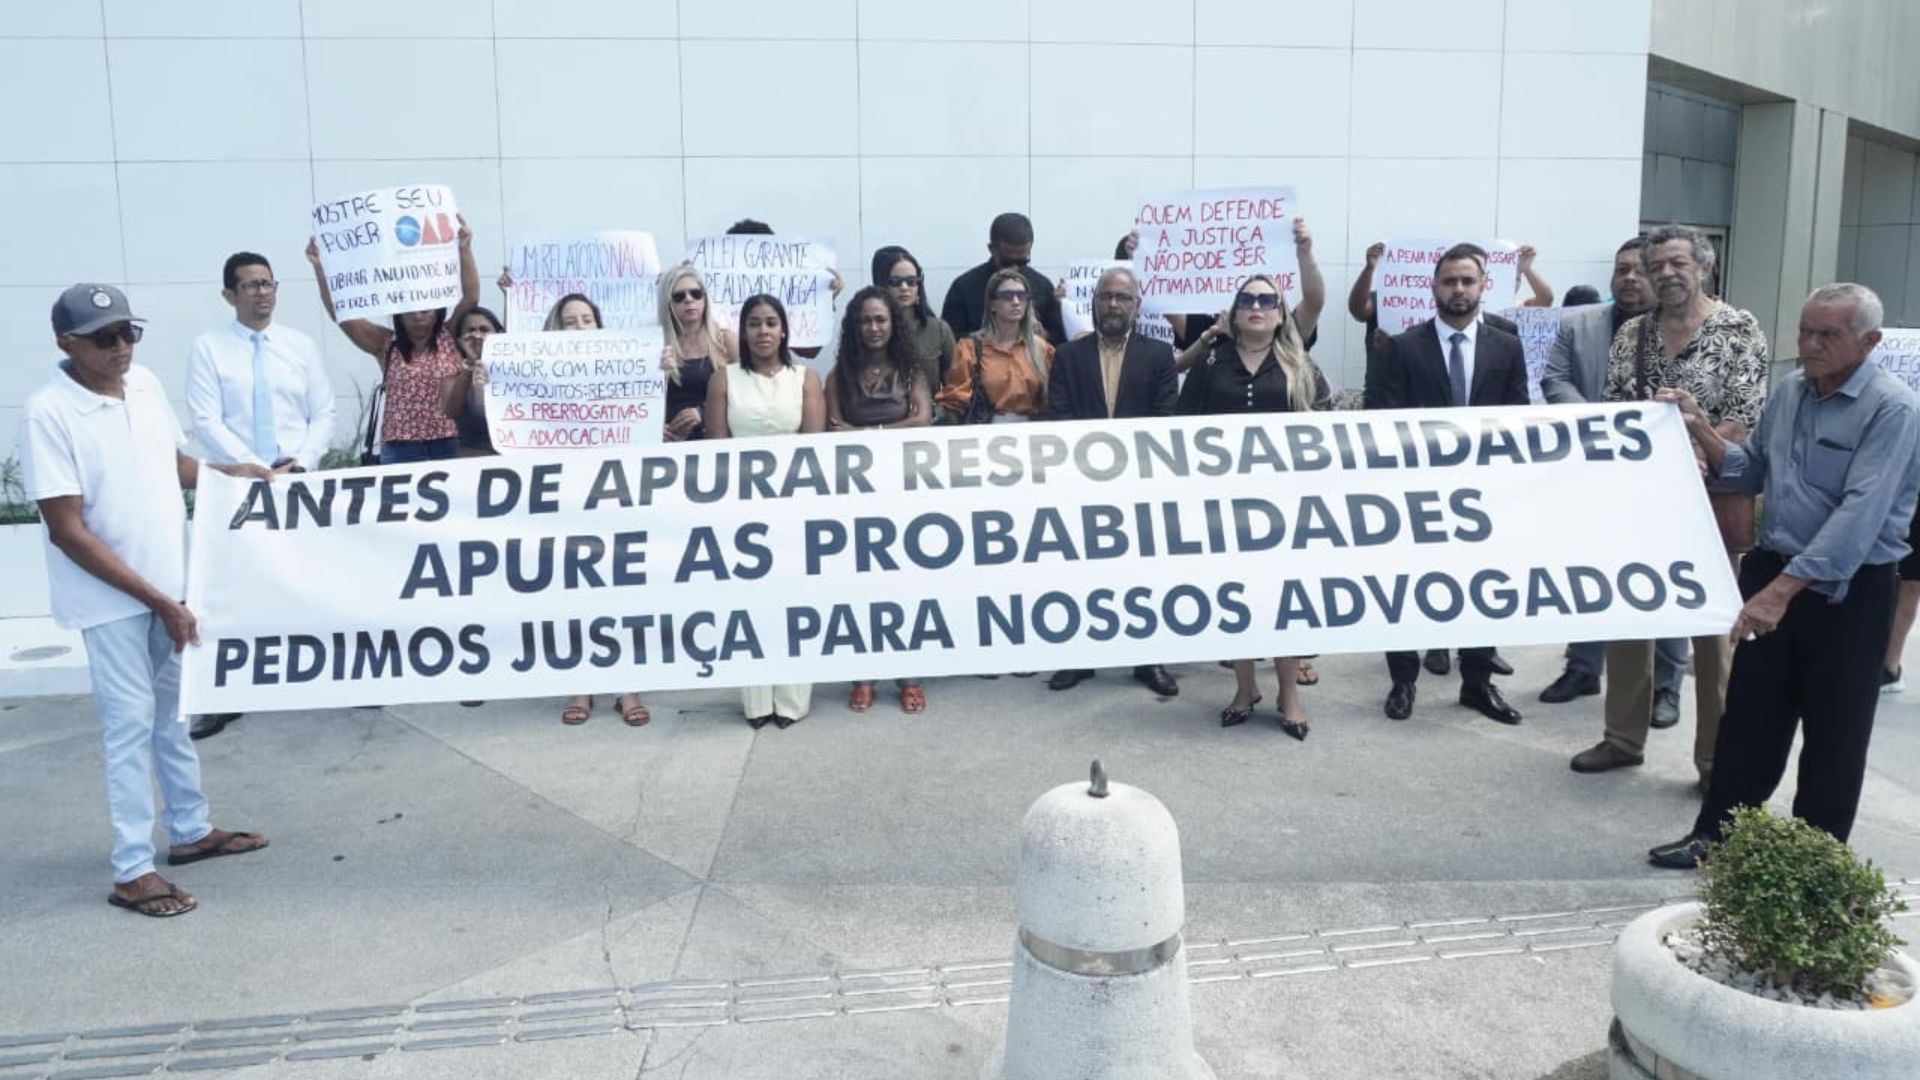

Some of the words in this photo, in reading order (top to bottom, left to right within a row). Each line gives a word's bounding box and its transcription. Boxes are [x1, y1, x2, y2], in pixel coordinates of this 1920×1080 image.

[395, 188, 442, 209] SEU
[1141, 203, 1192, 226] QUEM
[1201, 197, 1285, 223] DEFENDE
[321, 221, 380, 254] PODER
[1158, 229, 1171, 248] A
[1181, 225, 1264, 250] JUSTIÇA
[691, 237, 708, 268] A
[710, 236, 736, 269] LEI
[743, 237, 812, 270] GARANTE
[1144, 248, 1180, 273] NÃO
[1181, 248, 1227, 271] PODE
[1233, 244, 1267, 267] SER
[1397, 248, 1426, 264] PENA
[1486, 250, 1517, 265] ASSAR
[1139, 273, 1192, 298] VÍTIMA
[1194, 275, 1214, 294] DA
[1384, 274, 1398, 288] DA
[1382, 296, 1408, 309] NEM
[1410, 297, 1426, 309] DA
[491, 342, 526, 357] SEM
[551, 360, 588, 378] COM
[594, 358, 647, 376] RATOS
[503, 402, 526, 420] AS
[531, 402, 649, 421] PRERROGATIVAS
[496, 428, 517, 445] DA
[228, 469, 450, 532] ANTES
[476, 463, 563, 519] DE
[584, 444, 875, 511] APURAR
[902, 409, 1653, 491] RESPONSABILIDADES
[400, 530, 648, 600] APURE
[674, 522, 774, 583] AS
[804, 488, 1493, 576] PROBABILIDADES
[214, 623, 491, 688] PEDIMOS
[511, 609, 765, 679] JUSTIÇA
[786, 598, 955, 658] PARA
[976, 581, 1252, 647] NOSSOS
[1274, 560, 1707, 631] ADVOGADOS
